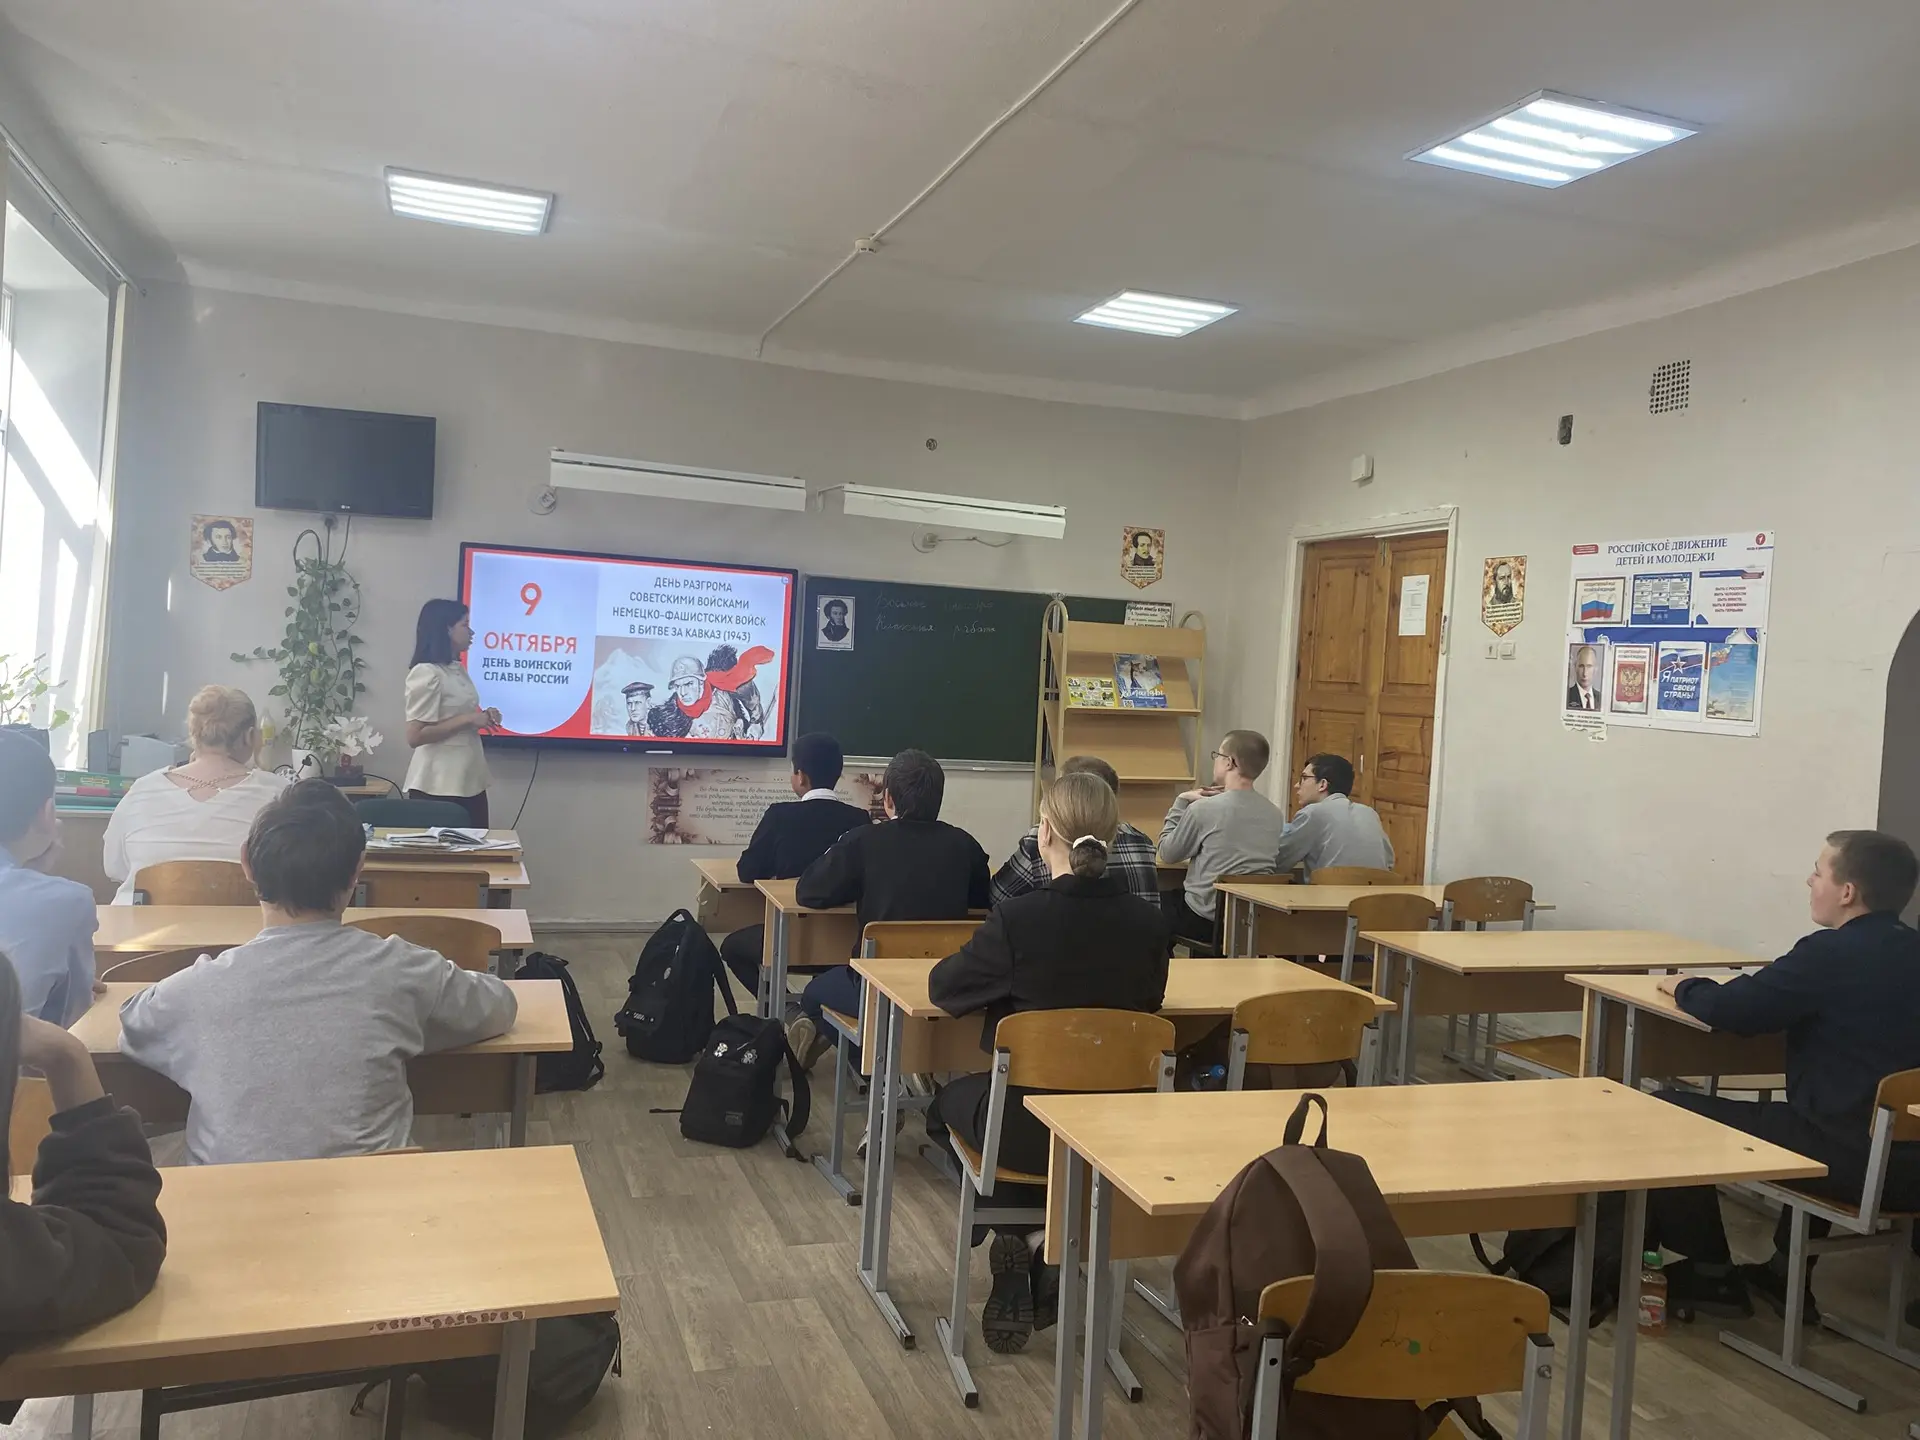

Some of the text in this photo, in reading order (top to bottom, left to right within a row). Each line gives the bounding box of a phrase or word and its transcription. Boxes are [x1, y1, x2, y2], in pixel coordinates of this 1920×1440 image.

[1608, 542, 1669, 554] РОССИЙСКОЕ
[1671, 538, 1727, 551] ДВИЖЕНИЕ
[1616, 552, 1715, 566] ДЕТЕЙ И МОЛОДЕЖИ
[654, 577, 732, 592] ДЕНЬ РАЗГРОМА
[520, 582, 542, 616] 9
[629, 592, 749, 609] СОВЕТСКИМИ ВОЙСКАМИ
[612, 606, 766, 626] НЕМЕЦКО-ФАШИСТСКИХ ВОЙСК
[629, 624, 751, 643] В БИТВЕ ЗА КАВКАЗ (1943)
[484, 631, 577, 654] ОКТЯБРЯ
[482, 657, 572, 671] ДЕНЬ ВОИНСКОЙ
[484, 671, 569, 684] СЛАВЫ РОССИИ
[1661, 671, 1699, 684] Я ПАТРИОТ
